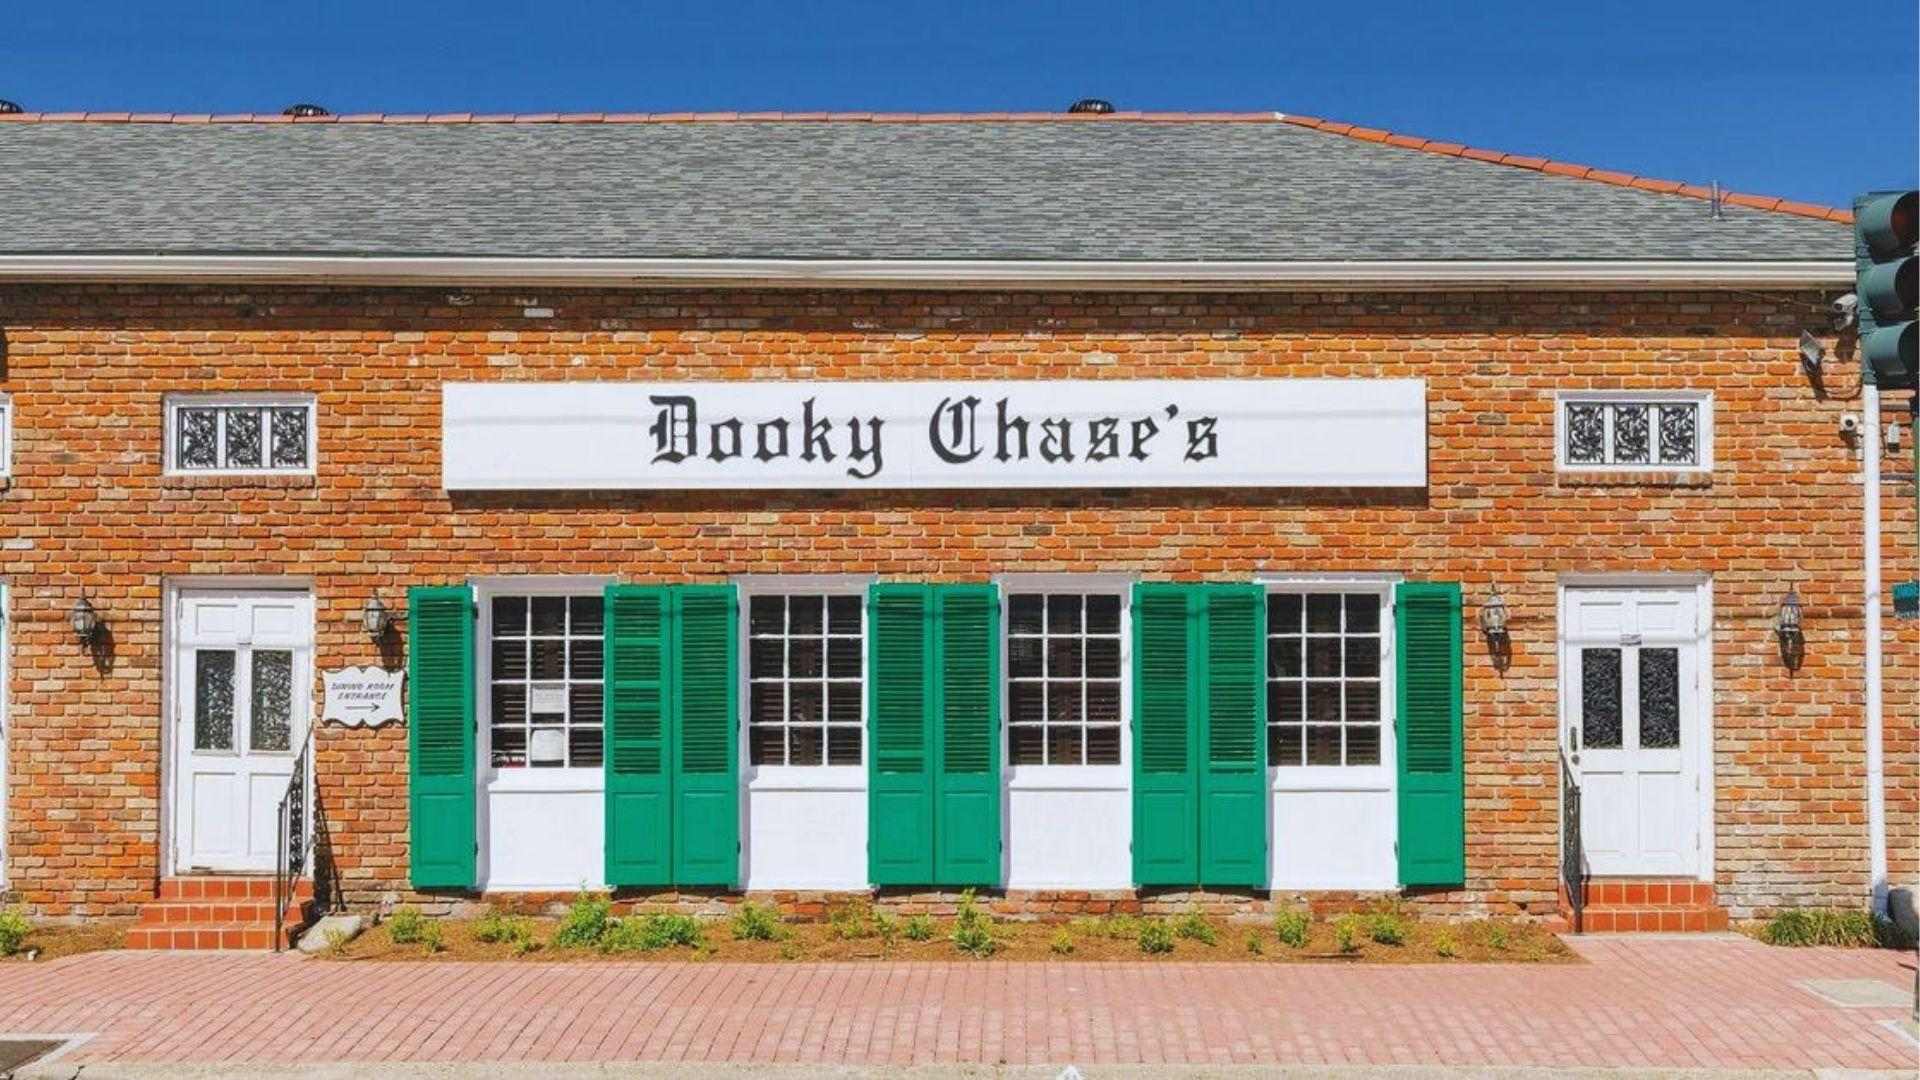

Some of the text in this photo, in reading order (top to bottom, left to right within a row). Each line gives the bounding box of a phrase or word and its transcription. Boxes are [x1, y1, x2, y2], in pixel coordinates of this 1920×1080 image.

[649, 395, 1219, 480] Dooky Chase's
[331, 682, 395, 691] DINING ROOM
[337, 692, 388, 701] ENTRANCE
